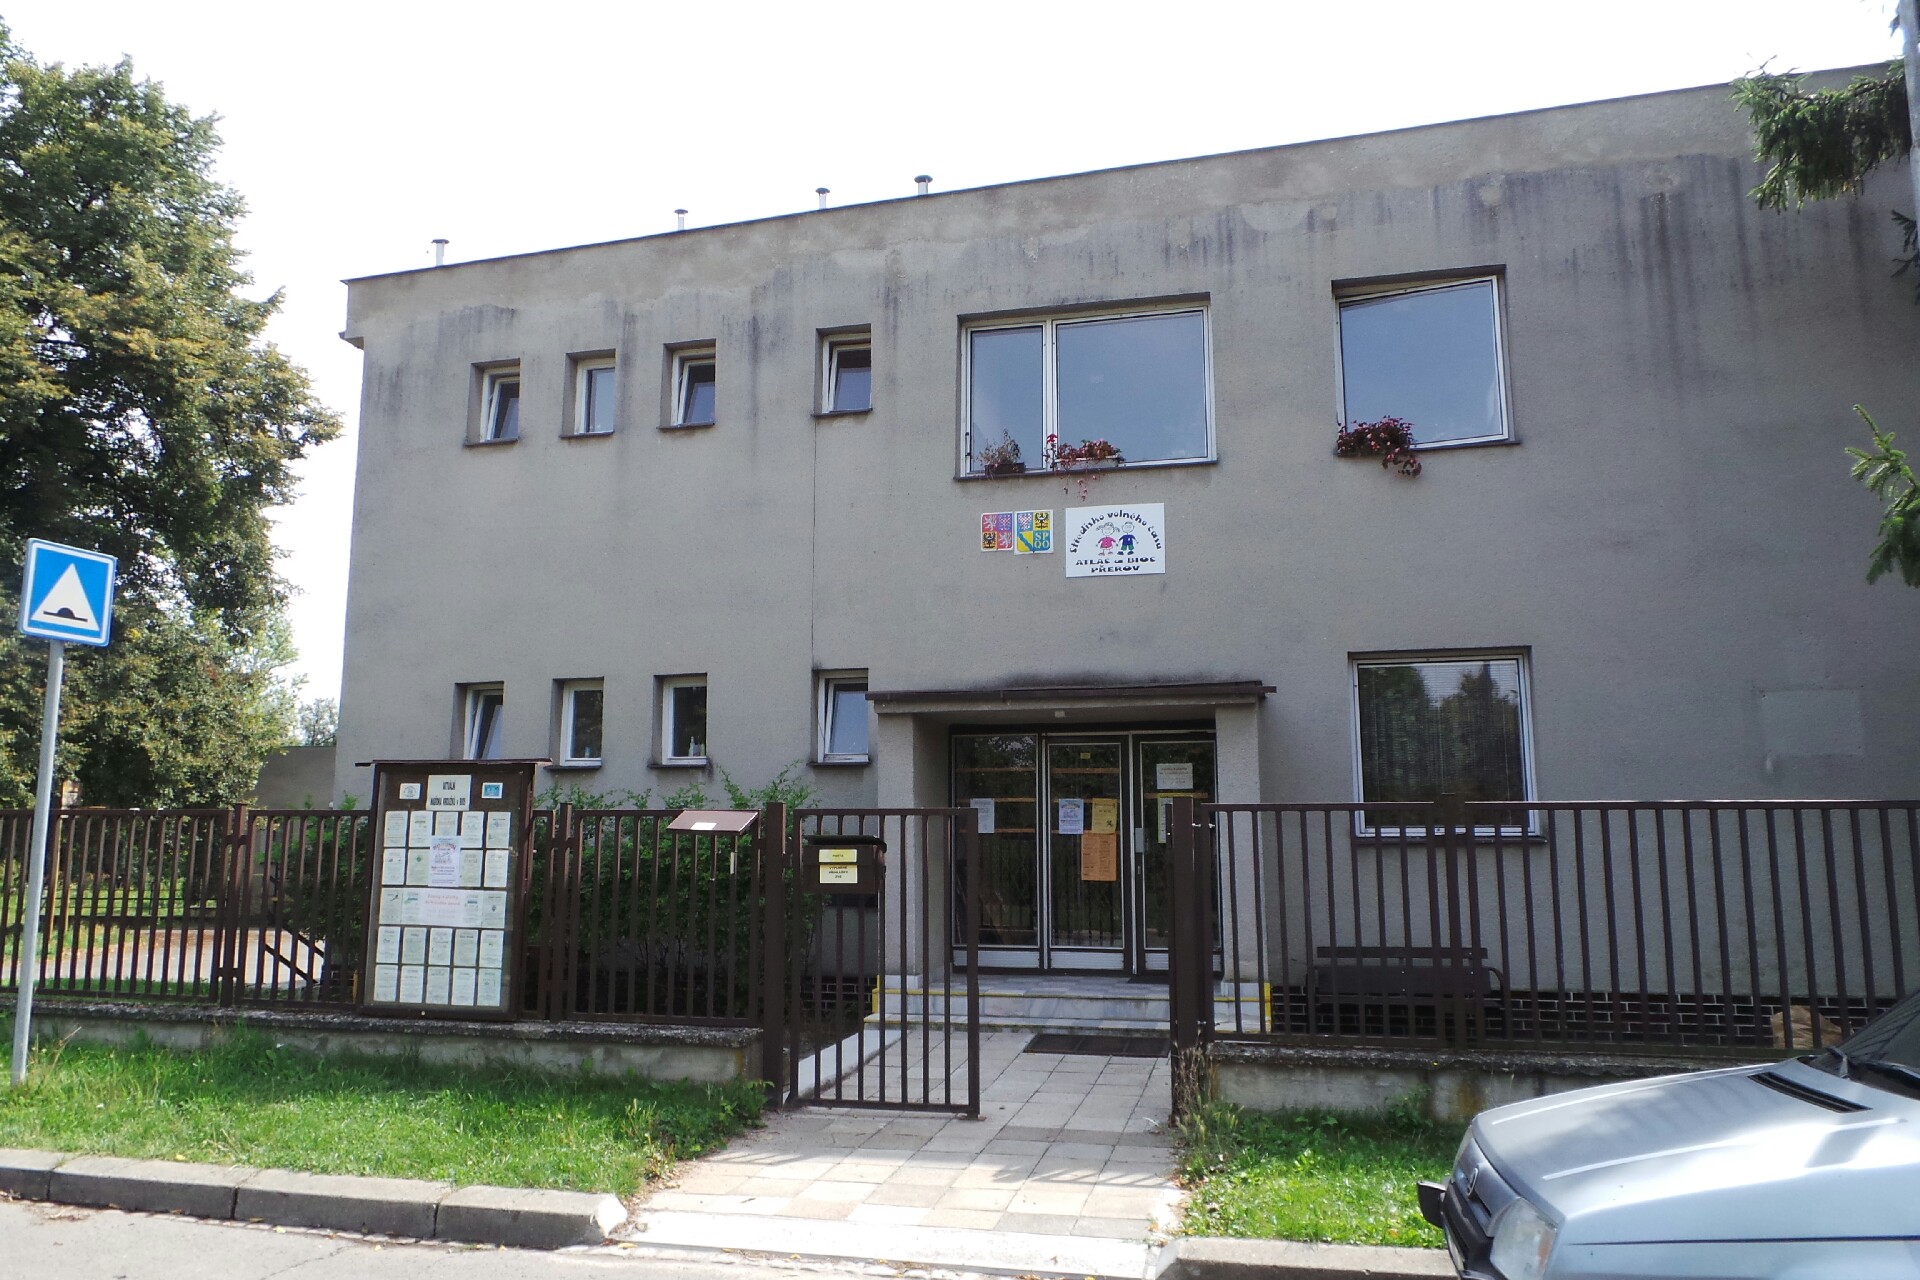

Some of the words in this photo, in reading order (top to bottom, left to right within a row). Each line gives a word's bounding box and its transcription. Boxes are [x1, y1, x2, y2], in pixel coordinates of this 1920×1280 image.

[1107, 509, 1147, 526] volného
[1148, 525, 1162, 550] času
[1075, 558, 1111, 566] ATLAS
[1127, 556, 1156, 564] BIOS
[1090, 564, 1140, 573] PŘEROV
